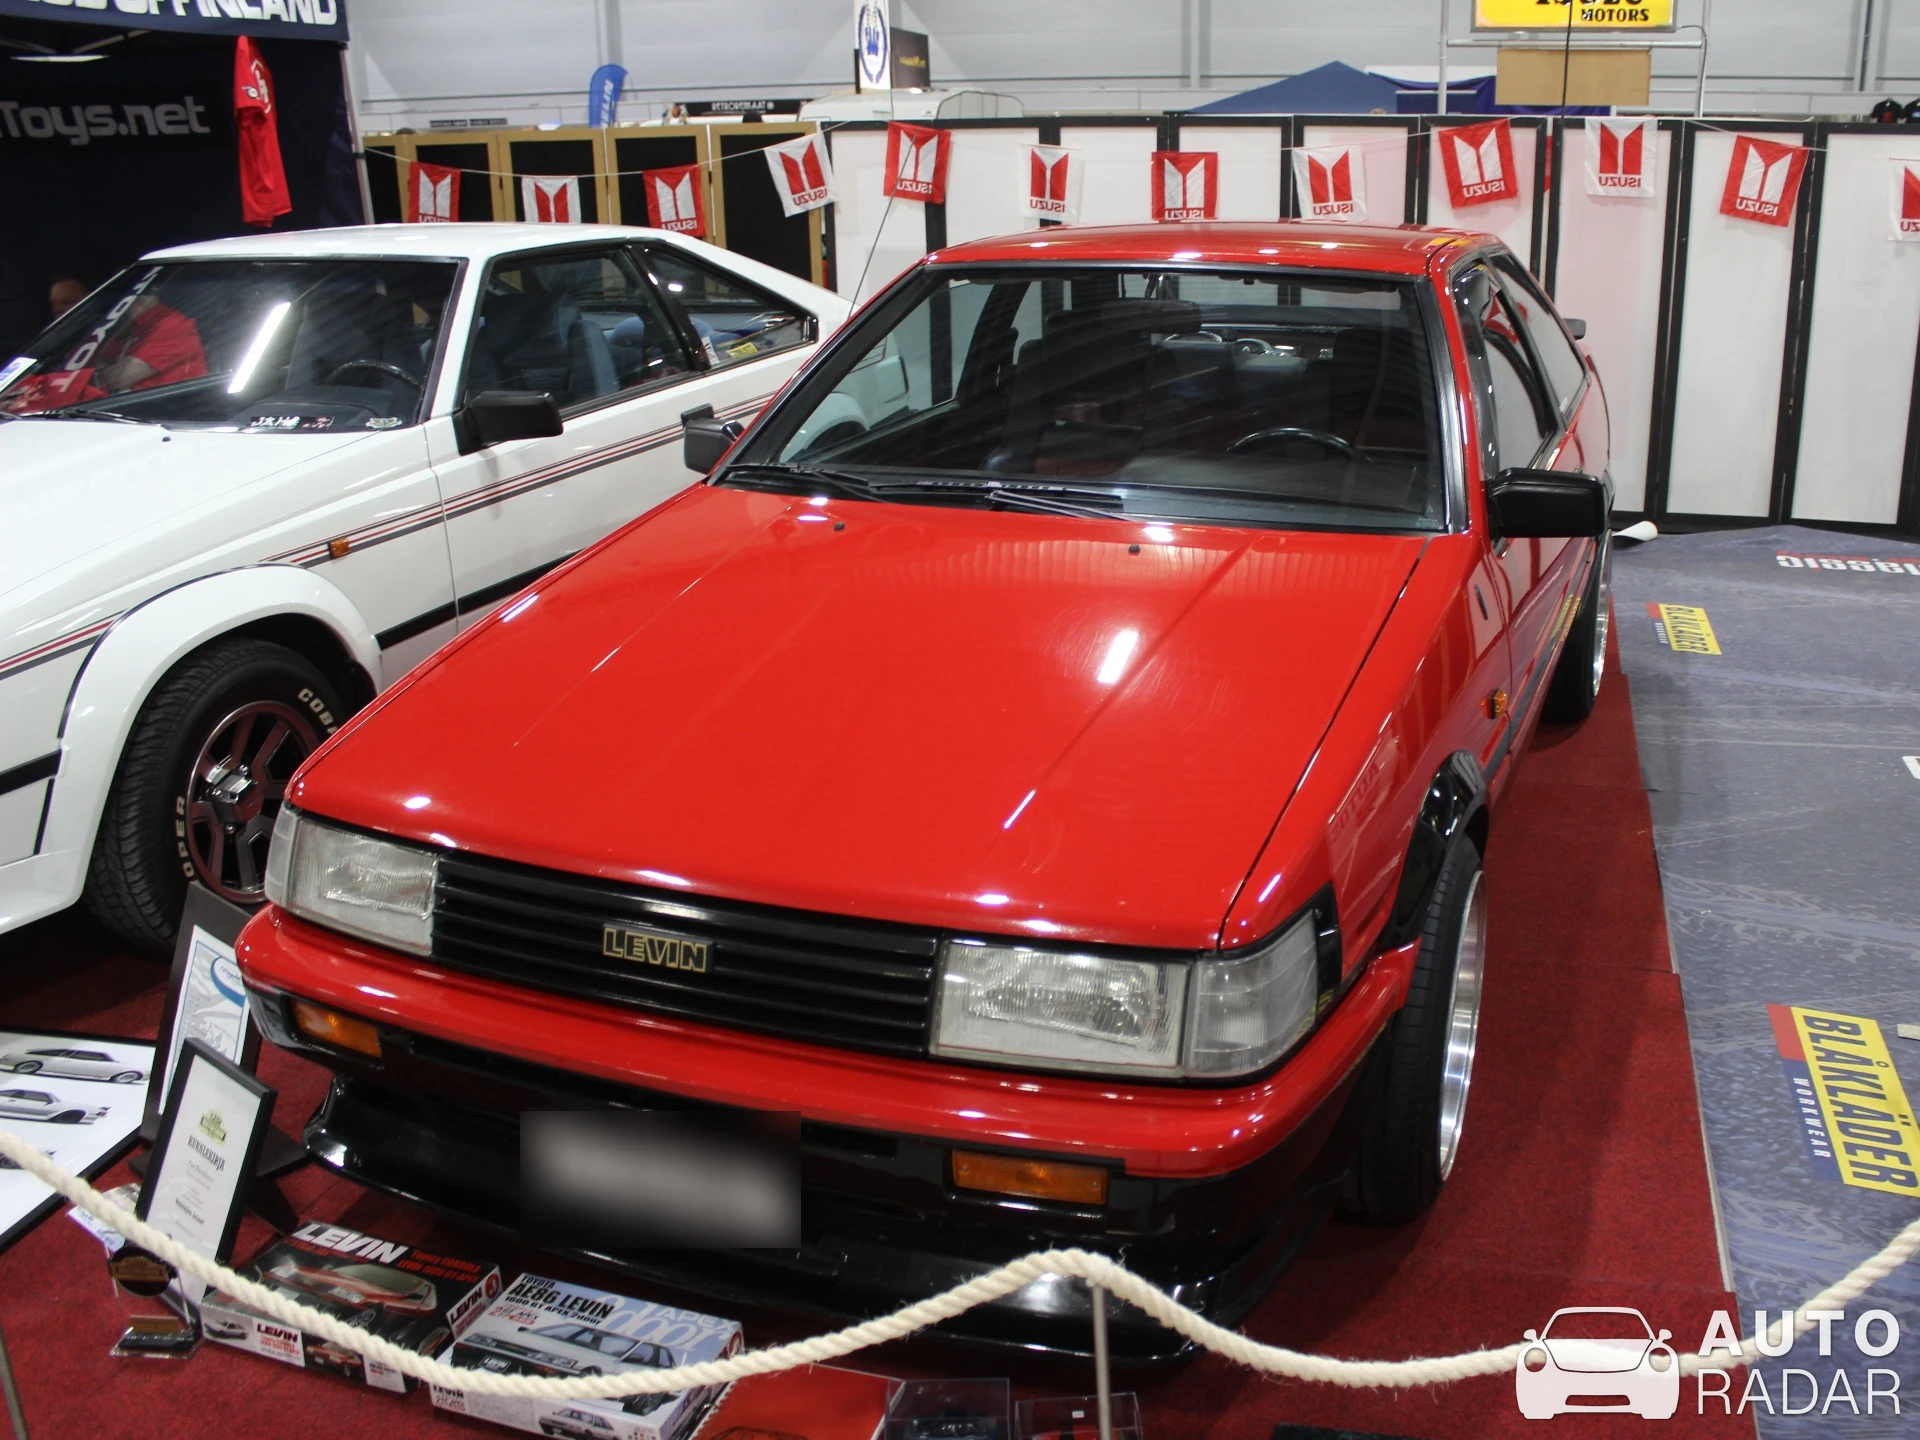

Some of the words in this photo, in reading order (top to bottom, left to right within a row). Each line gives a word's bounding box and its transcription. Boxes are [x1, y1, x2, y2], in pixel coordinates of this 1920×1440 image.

[1581, 8, 1650, 22] MOTORS
[0, 95, 211, 146] Toys.net
[1776, 555, 1920, 576] lassic
[603, 927, 708, 973] LEVIN
[1793, 1077, 1831, 1158] WORKWEAR
[1803, 1015, 1920, 1188] BLÅKLÄDER
[291, 1223, 409, 1264] LEVIN
[522, 1274, 557, 1289] TOYOTA
[449, 1286, 483, 1325] LEVIN
[505, 1296, 531, 1306] 1600
[507, 1283, 561, 1304] AE86
[558, 1294, 616, 1320] LEVIN
[656, 1307, 741, 1331] APEX
[257, 1323, 299, 1343] LEVIN
